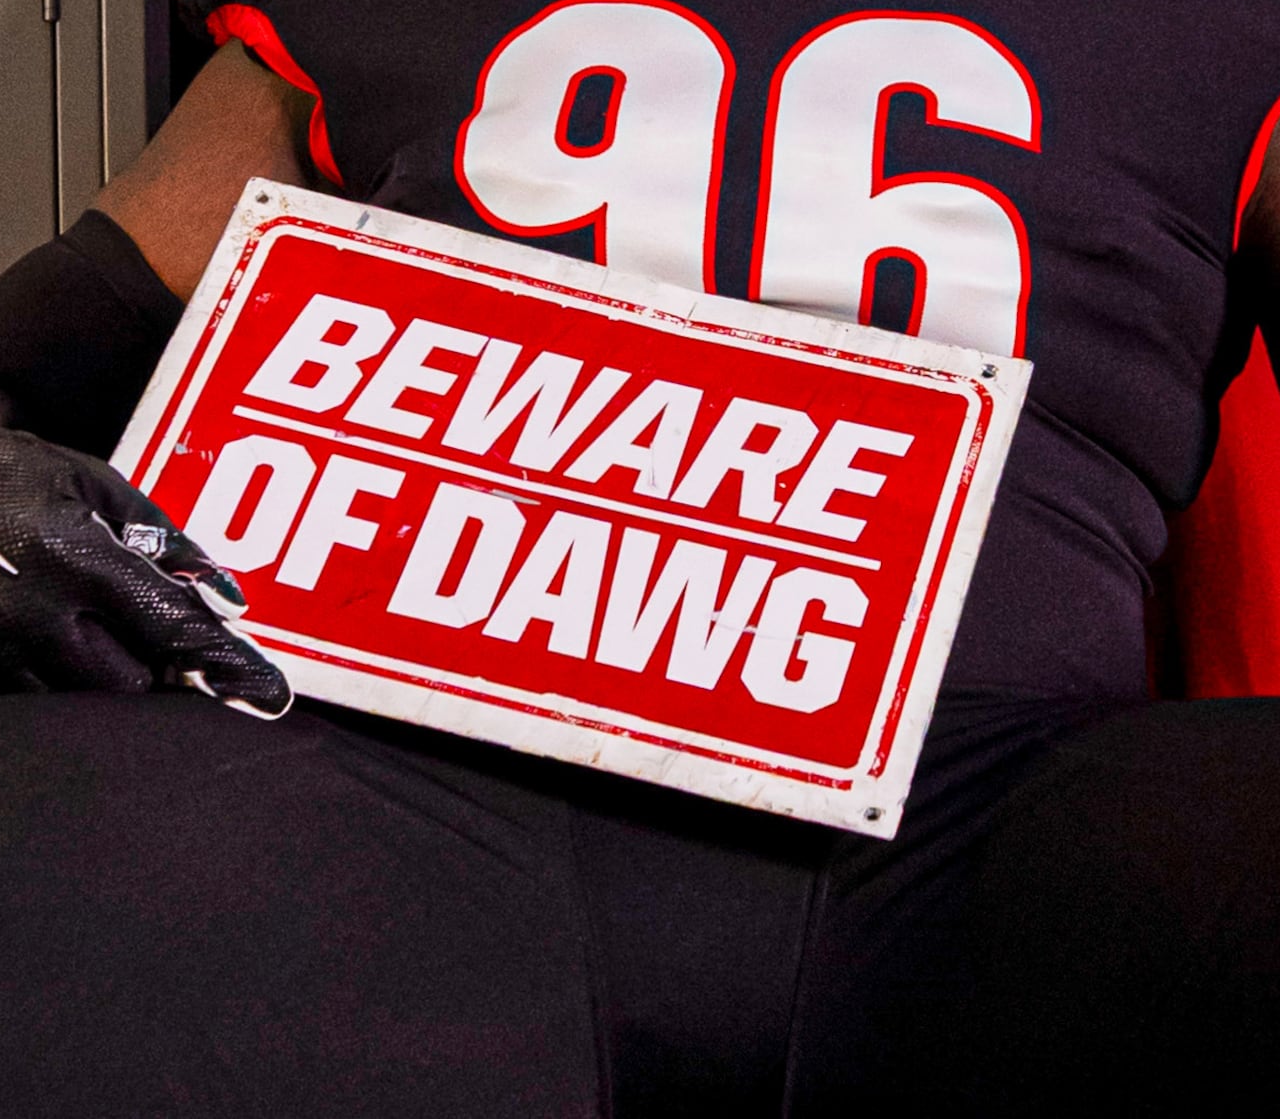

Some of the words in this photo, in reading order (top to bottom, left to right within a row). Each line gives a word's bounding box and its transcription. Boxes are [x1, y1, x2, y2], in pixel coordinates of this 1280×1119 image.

[245, 294, 915, 543] BEWARE
[185, 434, 407, 591] OF
[387, 489, 869, 715] DAWG
